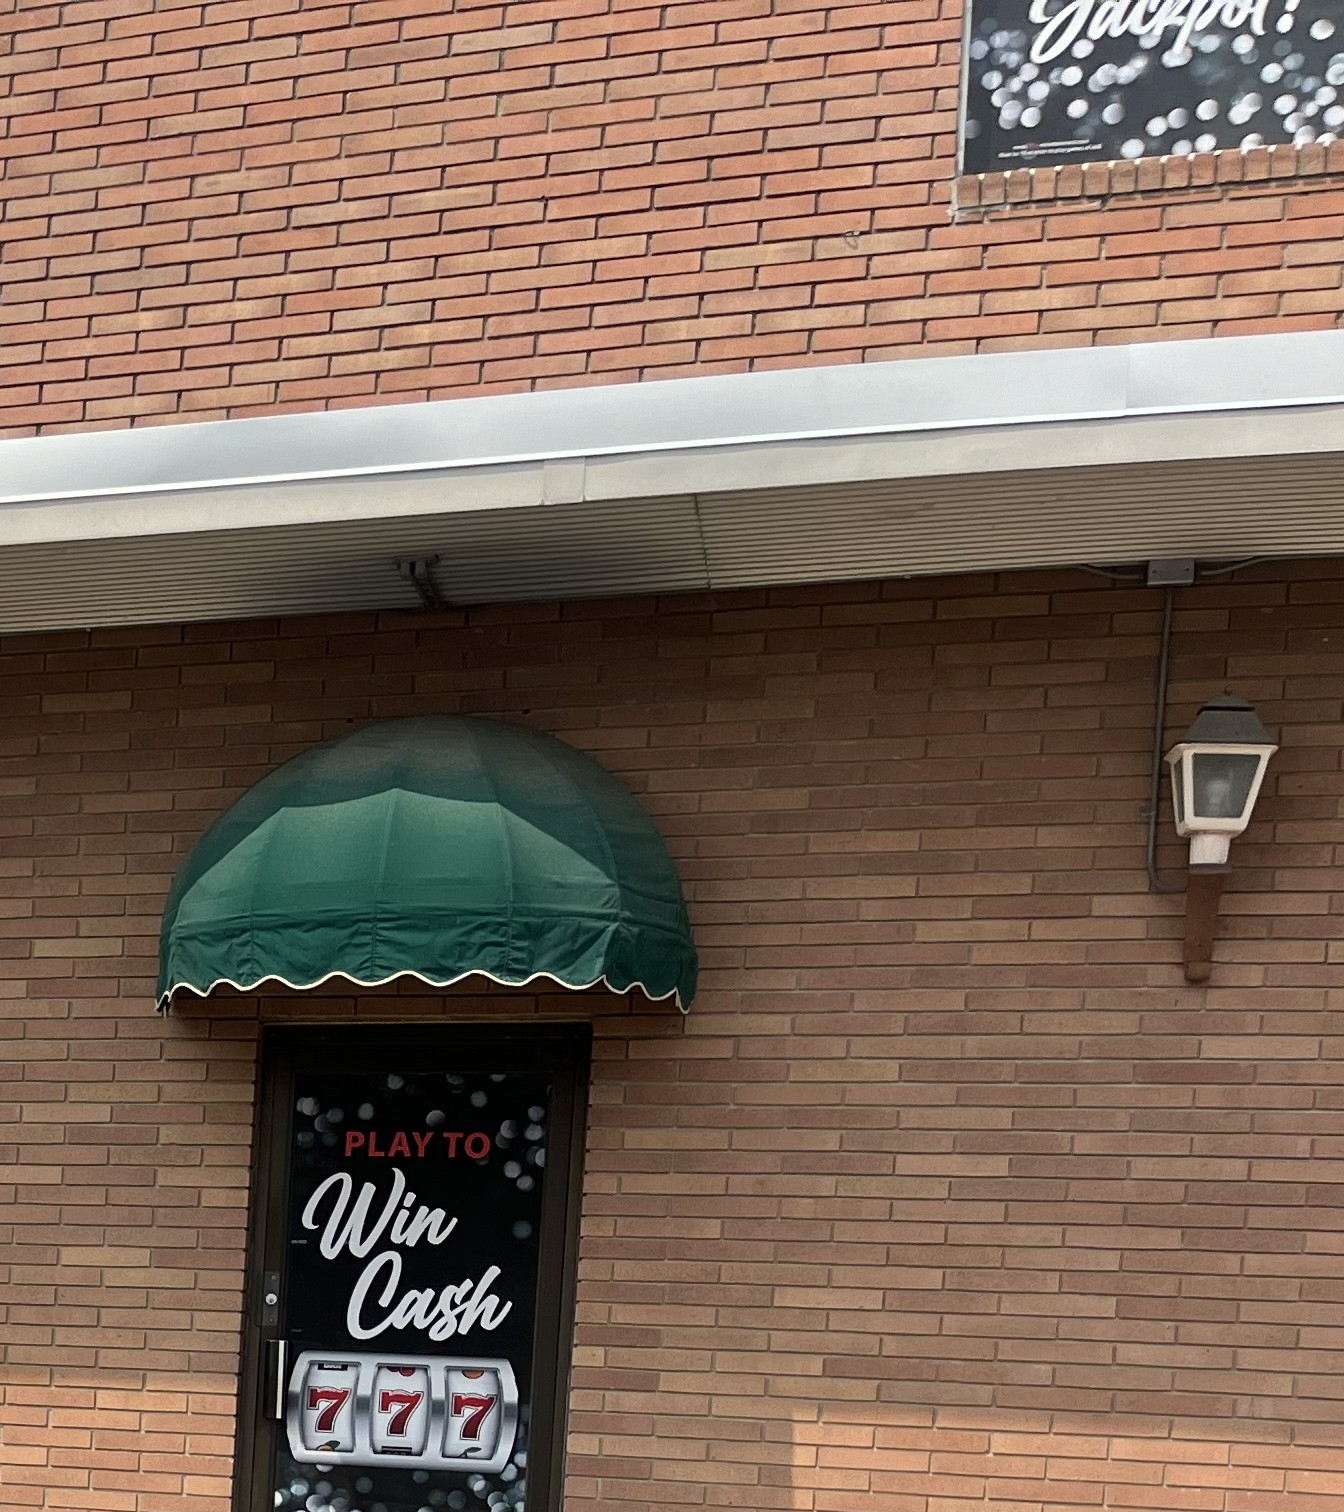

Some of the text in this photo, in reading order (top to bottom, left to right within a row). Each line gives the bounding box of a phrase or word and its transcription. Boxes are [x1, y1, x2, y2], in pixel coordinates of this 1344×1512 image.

[345, 1131, 491, 1159] PLAY TO
[302, 1167, 458, 1260] Win
[347, 1250, 512, 1341] Cash
